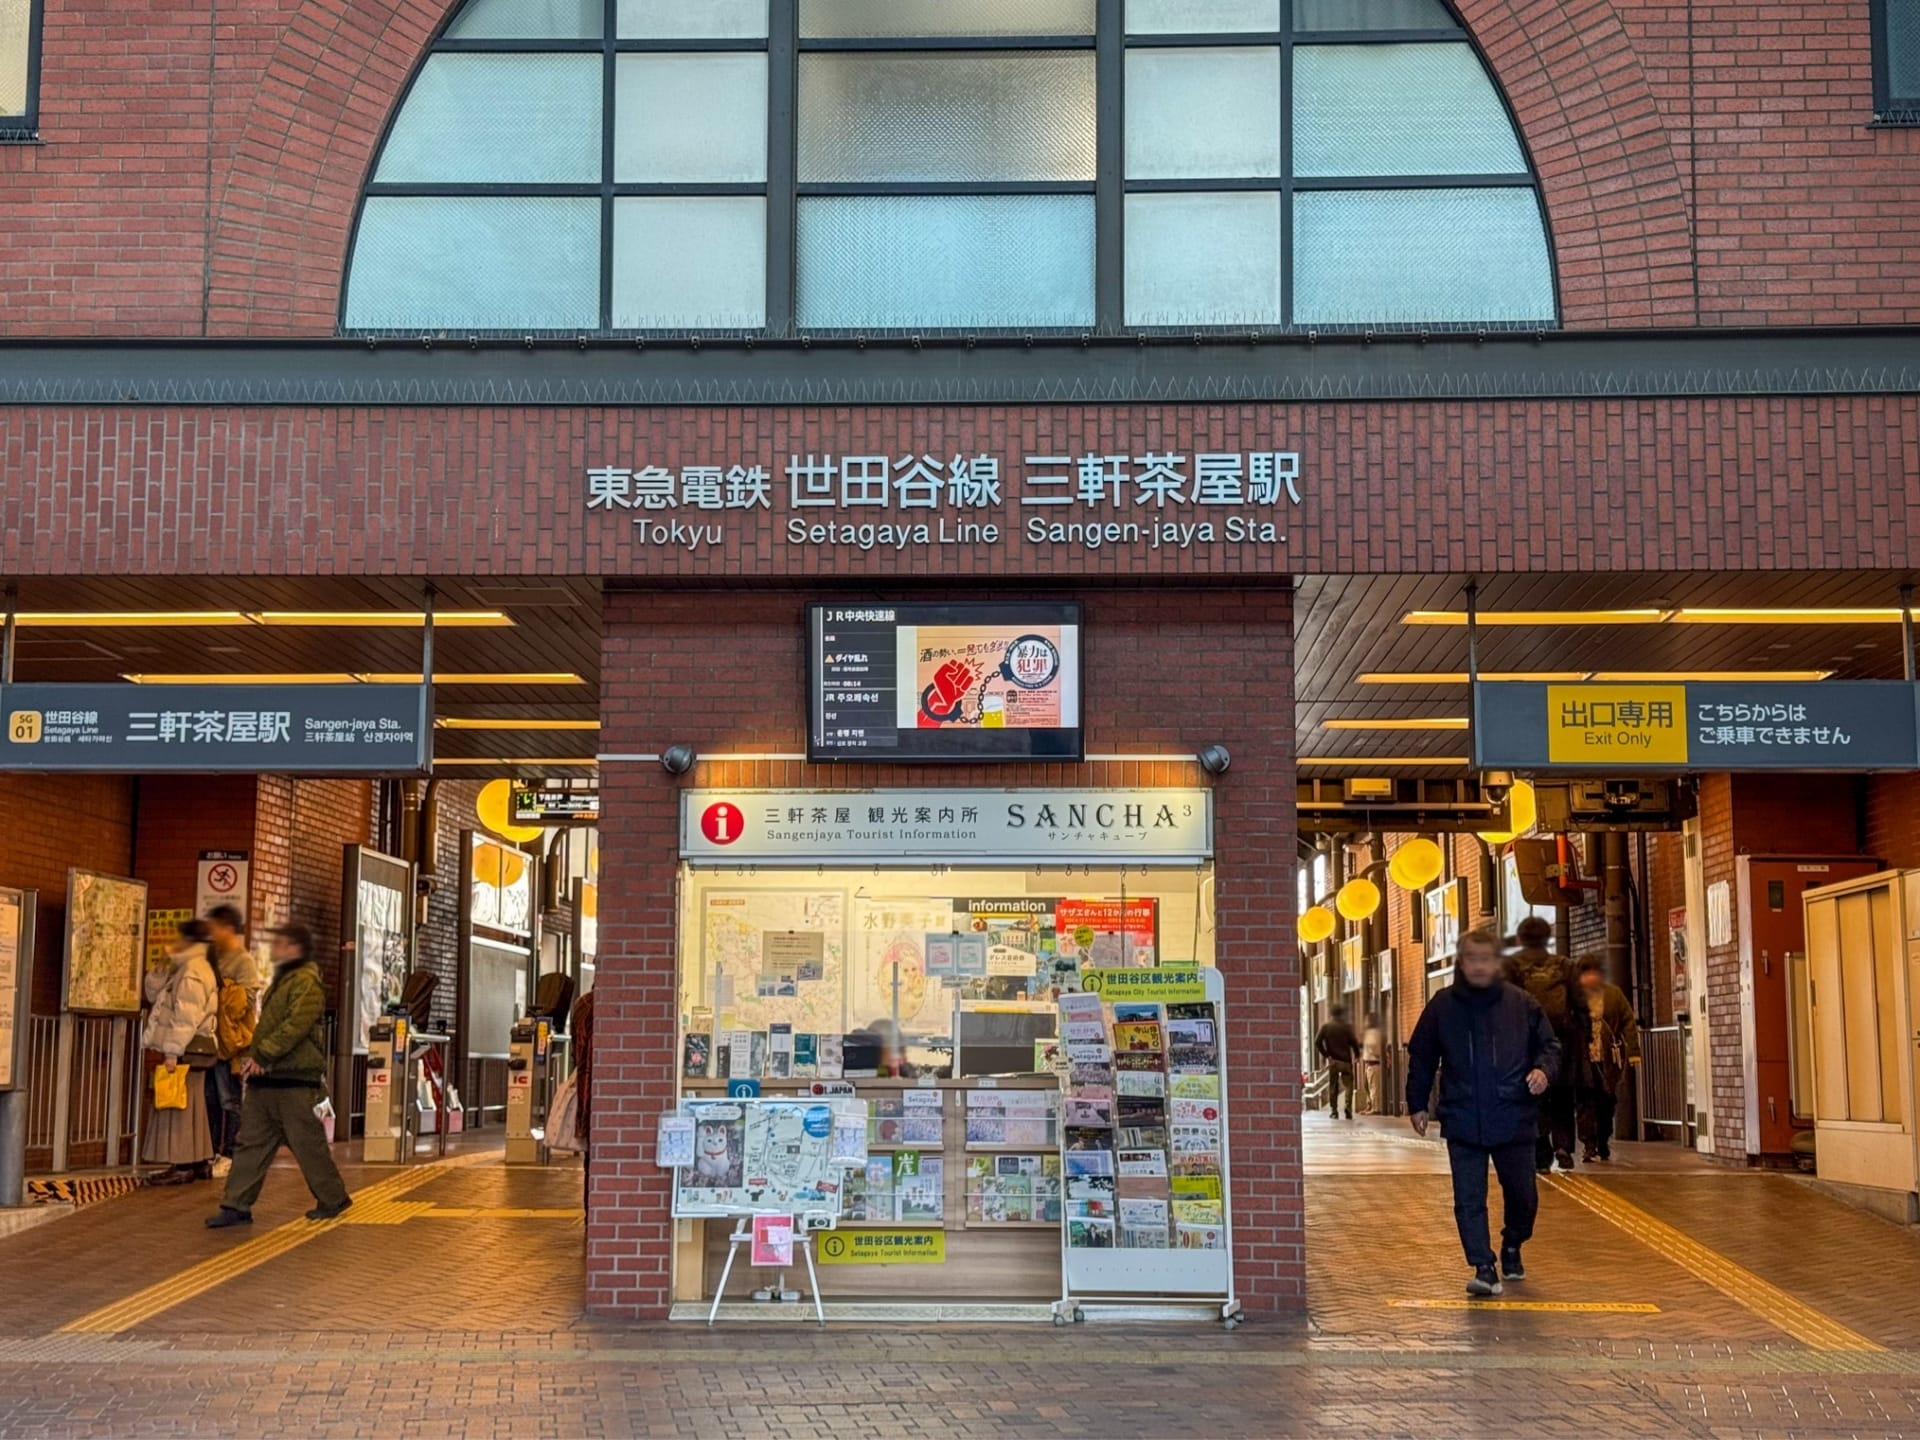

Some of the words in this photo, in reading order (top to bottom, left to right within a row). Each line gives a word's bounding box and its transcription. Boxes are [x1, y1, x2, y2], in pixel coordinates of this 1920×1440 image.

[586, 465, 771, 510] 東急電鉄
[785, 454, 1002, 509] 世田谷線
[1021, 452, 1300, 506] 三軒茶屋駅
[632, 518, 724, 550] Tokyu
[787, 517, 930, 548] Setagaya
[939, 517, 999, 543] Line
[1027, 515, 1216, 549] Sangen-jaya
[1225, 515, 1287, 543] Sta.
[19, 714, 33, 724] SG
[45, 711, 98, 724] 世田谷線
[1561, 700, 1673, 728] 出口専用
[1698, 704, 1807, 722] こちらからは
[15, 725, 34, 739] 01
[44, 725, 80, 736] Setagaya
[82, 725, 98, 734] Line
[126, 711, 291, 743] 三軒茶屋駅
[305, 717, 376, 733] Sangen-jaya
[379, 717, 402, 730] Sta.
[1584, 731, 1612, 745] Exit
[1617, 731, 1651, 749] Only
[1698, 726, 1851, 745] ご乗車できません
[764, 807, 852, 824] 三軒茶屋
[867, 807, 980, 824] 観光案内所
[766, 829, 843, 842] Sangenjaya
[845, 829, 895, 841] Tourist
[898, 829, 977, 841] Information
[1106, 972, 1198, 985] 世田谷区観光案内
[372, 1074, 387, 1083] IC
[513, 1076, 528, 1085] IC
[855, 1235, 934, 1246] 世田谷区観光案内
